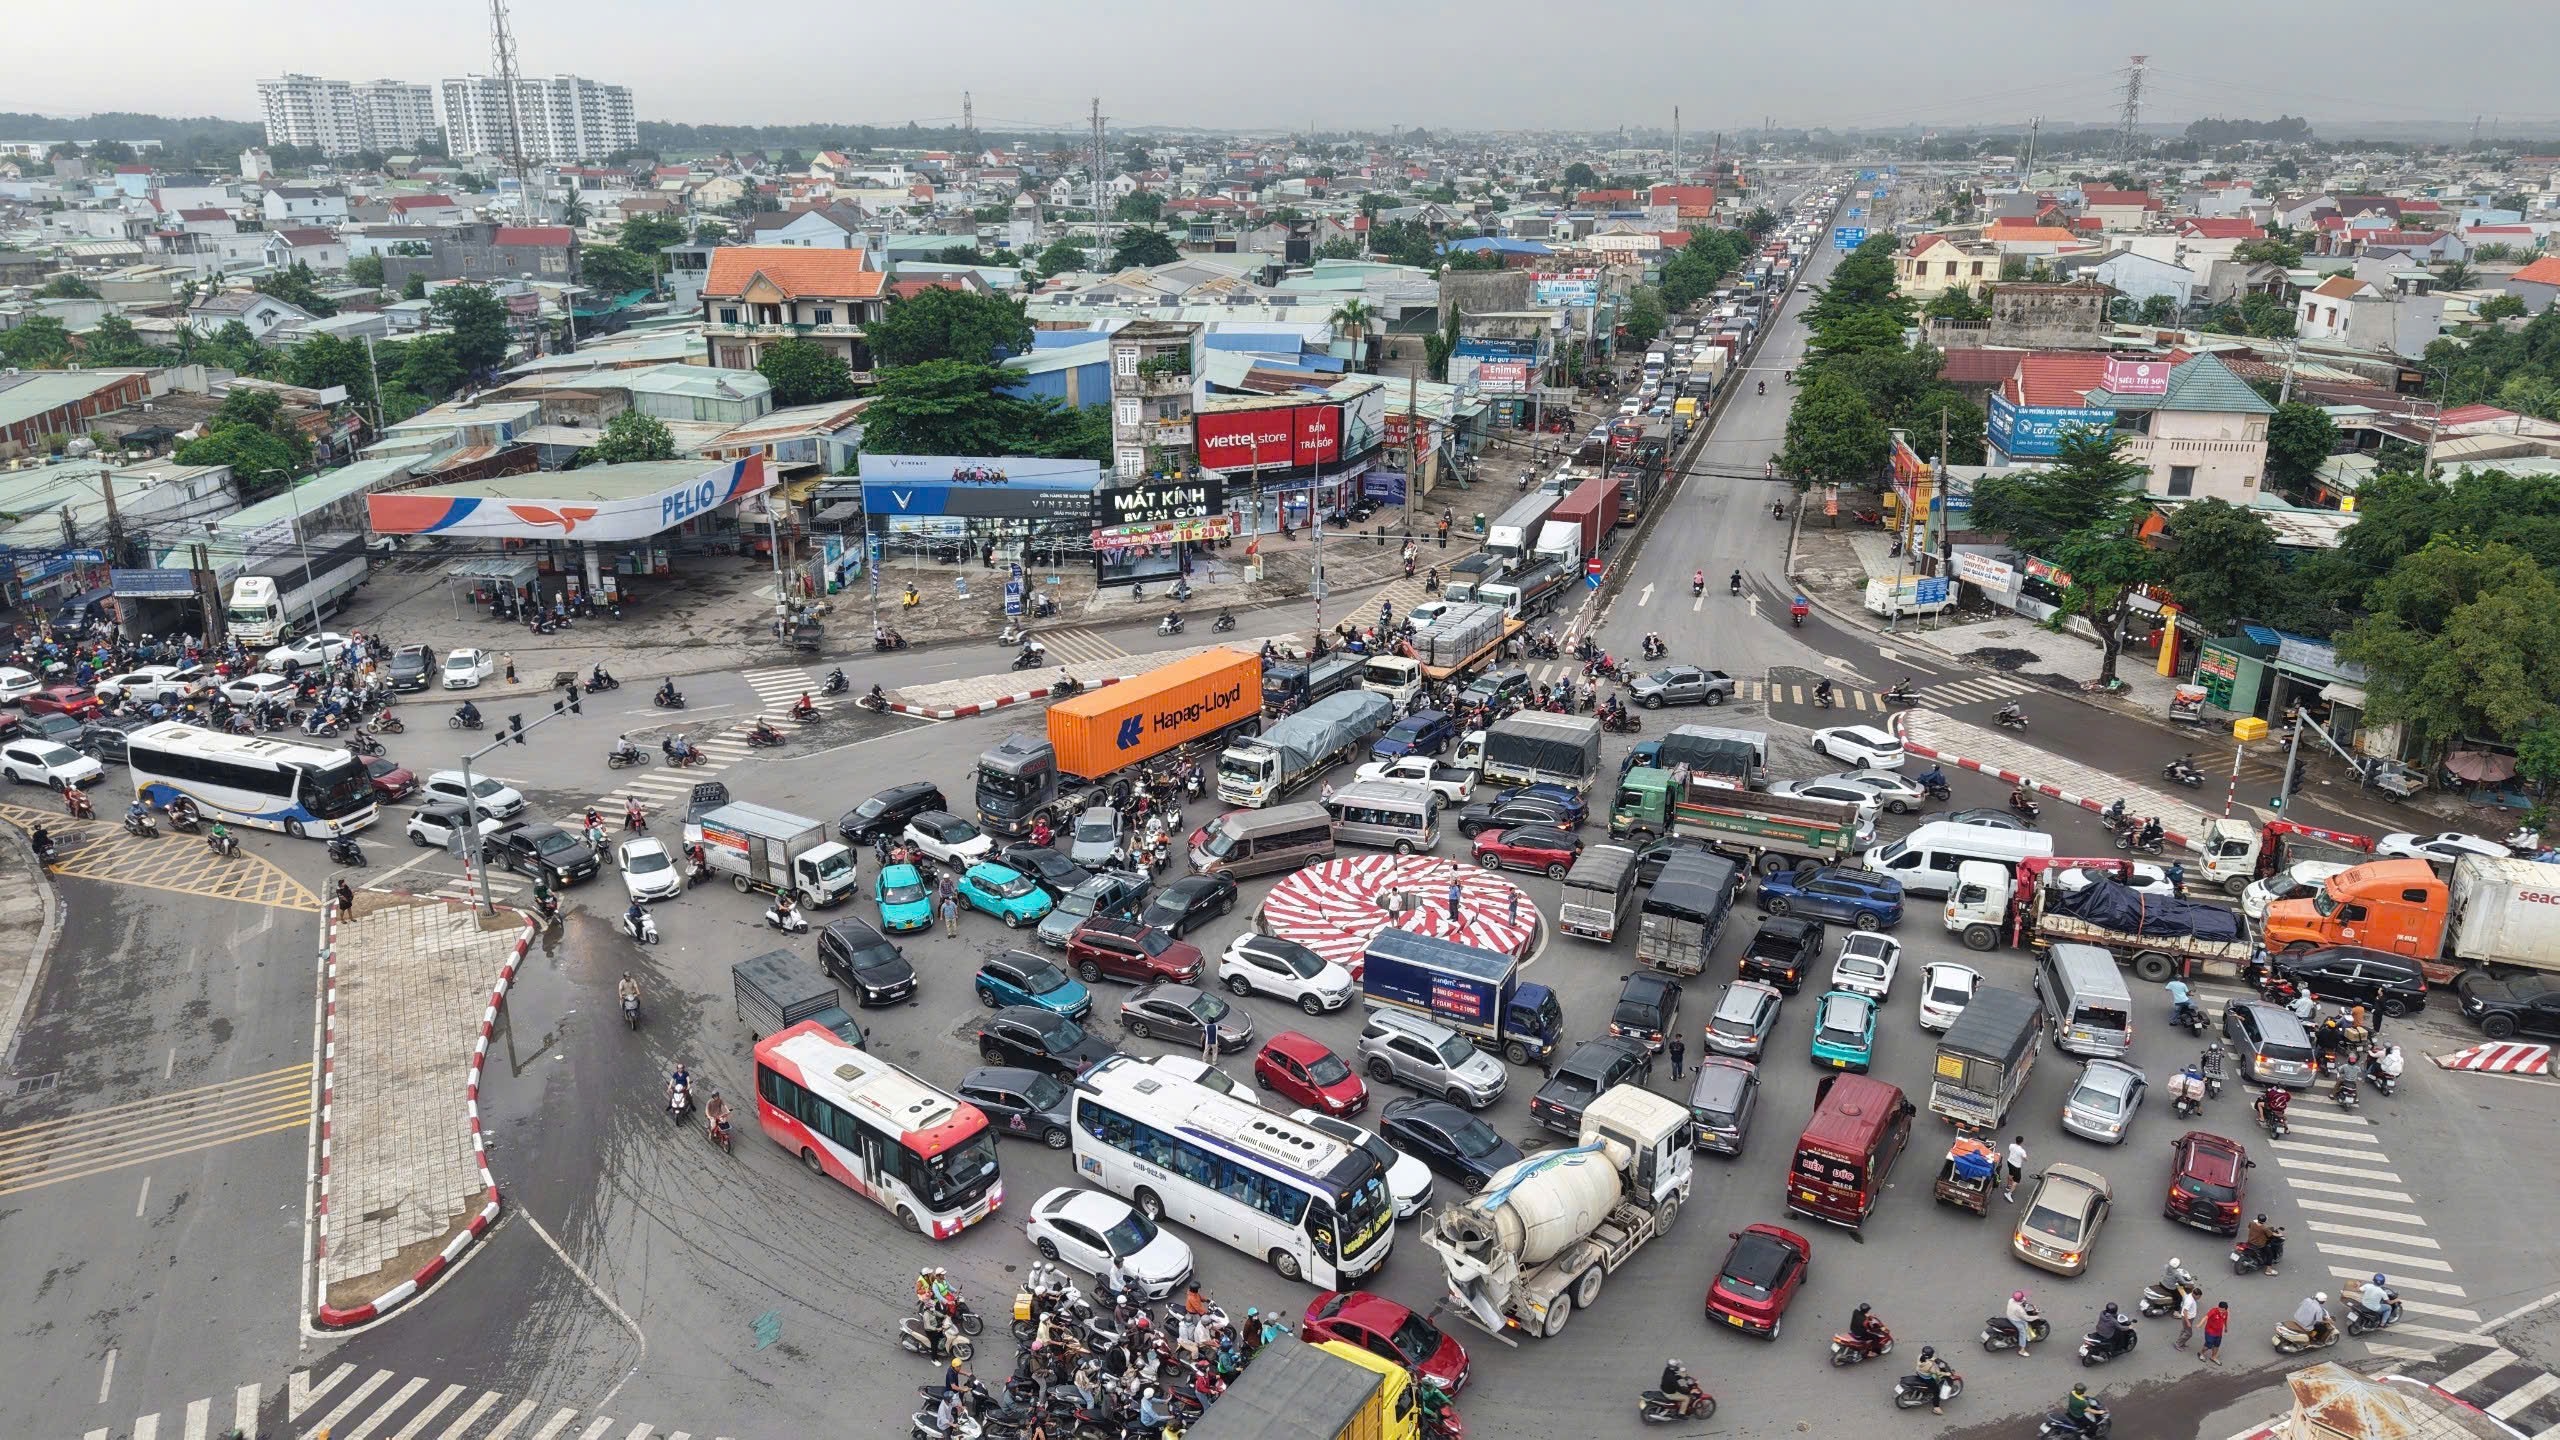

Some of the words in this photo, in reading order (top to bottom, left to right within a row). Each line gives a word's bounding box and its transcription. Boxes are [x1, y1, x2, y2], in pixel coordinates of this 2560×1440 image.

[1204, 432, 1254, 449] viettel
[1258, 433, 1287, 444] store
[1317, 438, 1333, 448] GÓP
[663, 480, 715, 526] PELIO
[1032, 501, 1090, 509] VINFAST
[1114, 486, 1156, 509] MẮT
[1162, 486, 1205, 506] KÍNH
[1179, 529, 1193, 540] 10
[1201, 527, 1224, 538] 20%
[1154, 683, 1240, 733] Hapag-Lloyd
